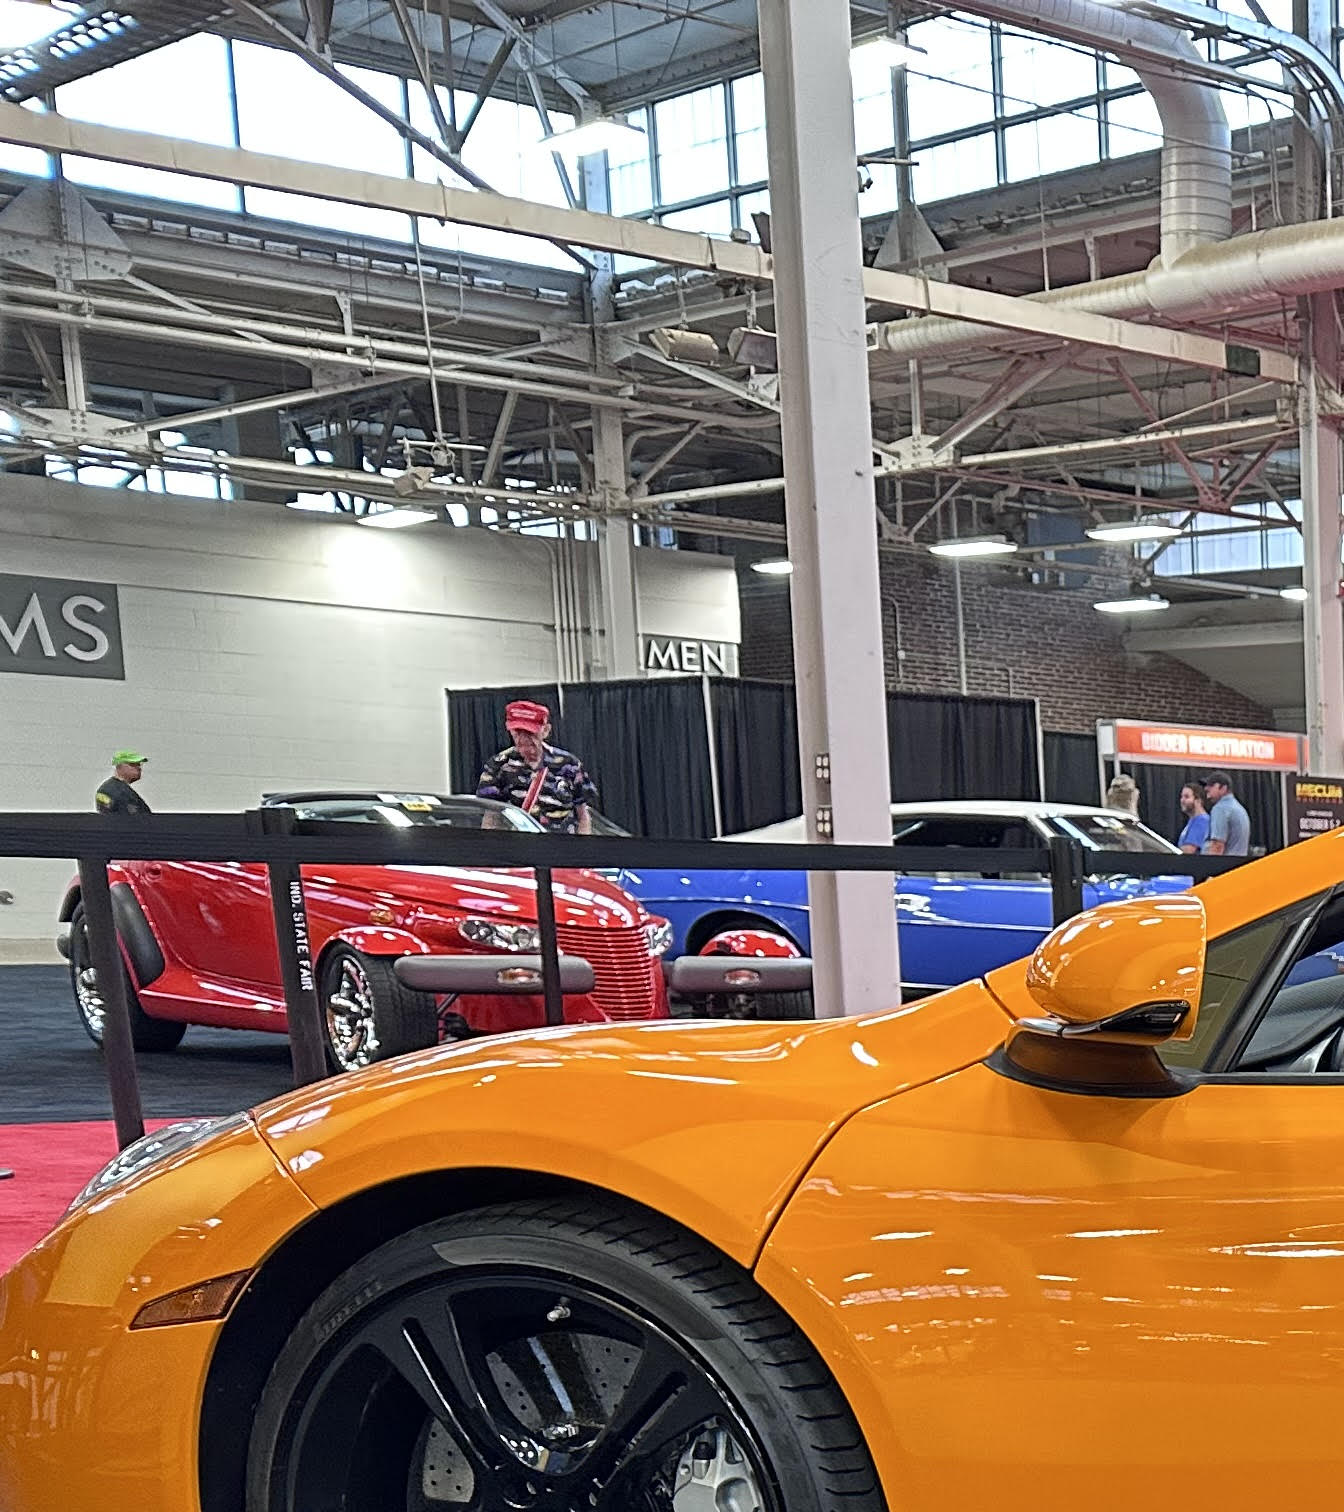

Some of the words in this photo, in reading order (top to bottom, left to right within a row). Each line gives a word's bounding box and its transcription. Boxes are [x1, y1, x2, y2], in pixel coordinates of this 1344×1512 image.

[0, 592, 109, 662] MS
[646, 639, 727, 675] MEN
[289, 881, 302, 909] IND.
[292, 912, 309, 954] STATE
[299, 960, 314, 991] FAIR
